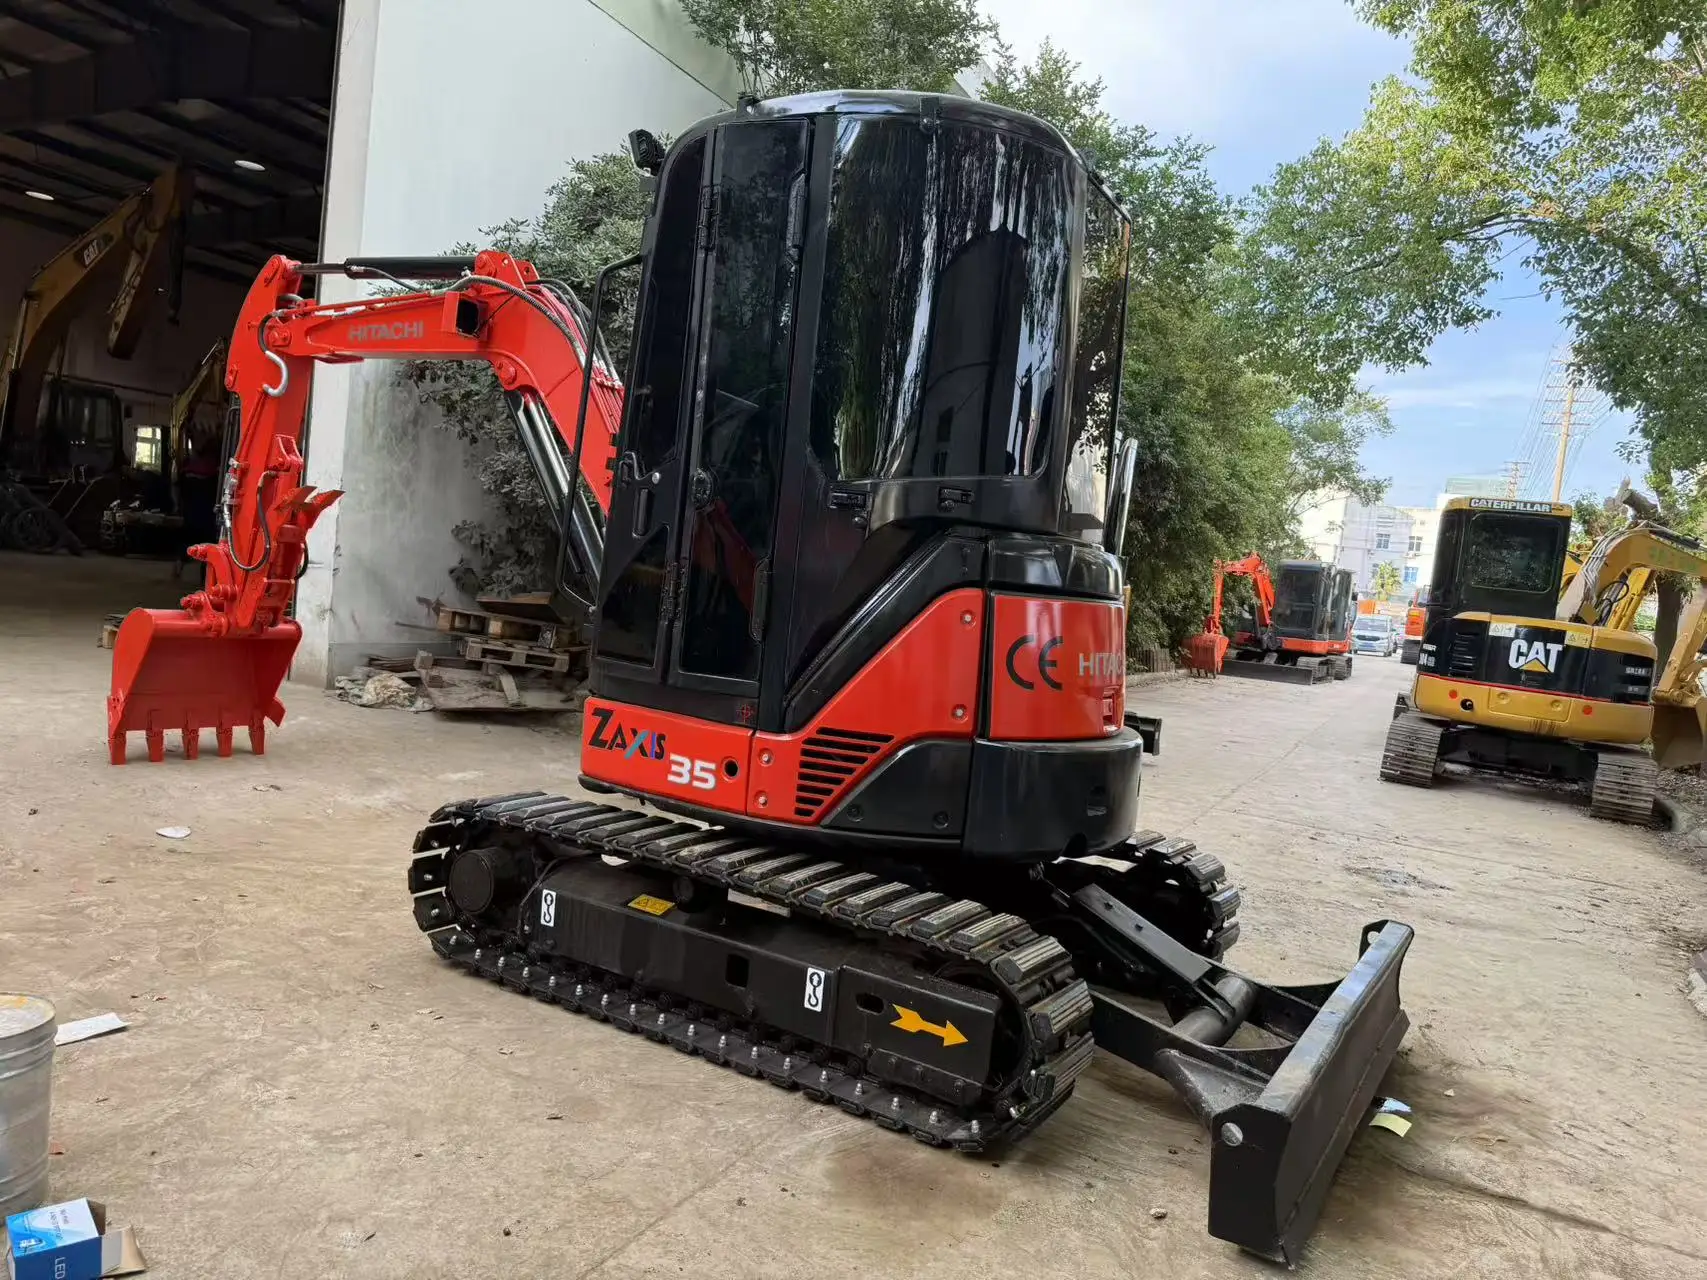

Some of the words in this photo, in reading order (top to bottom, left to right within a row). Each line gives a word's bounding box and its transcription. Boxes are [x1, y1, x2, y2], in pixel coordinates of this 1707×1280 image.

[83, 239, 99, 266] CAT
[348, 320, 425, 343] HITACHI
[1470, 498, 1551, 512] CATERPILLAR
[1508, 638, 1563, 673] CAT
[589, 707, 666, 761] ZAXIS
[667, 753, 718, 790] 35
[54, 1256, 66, 1280] LED
